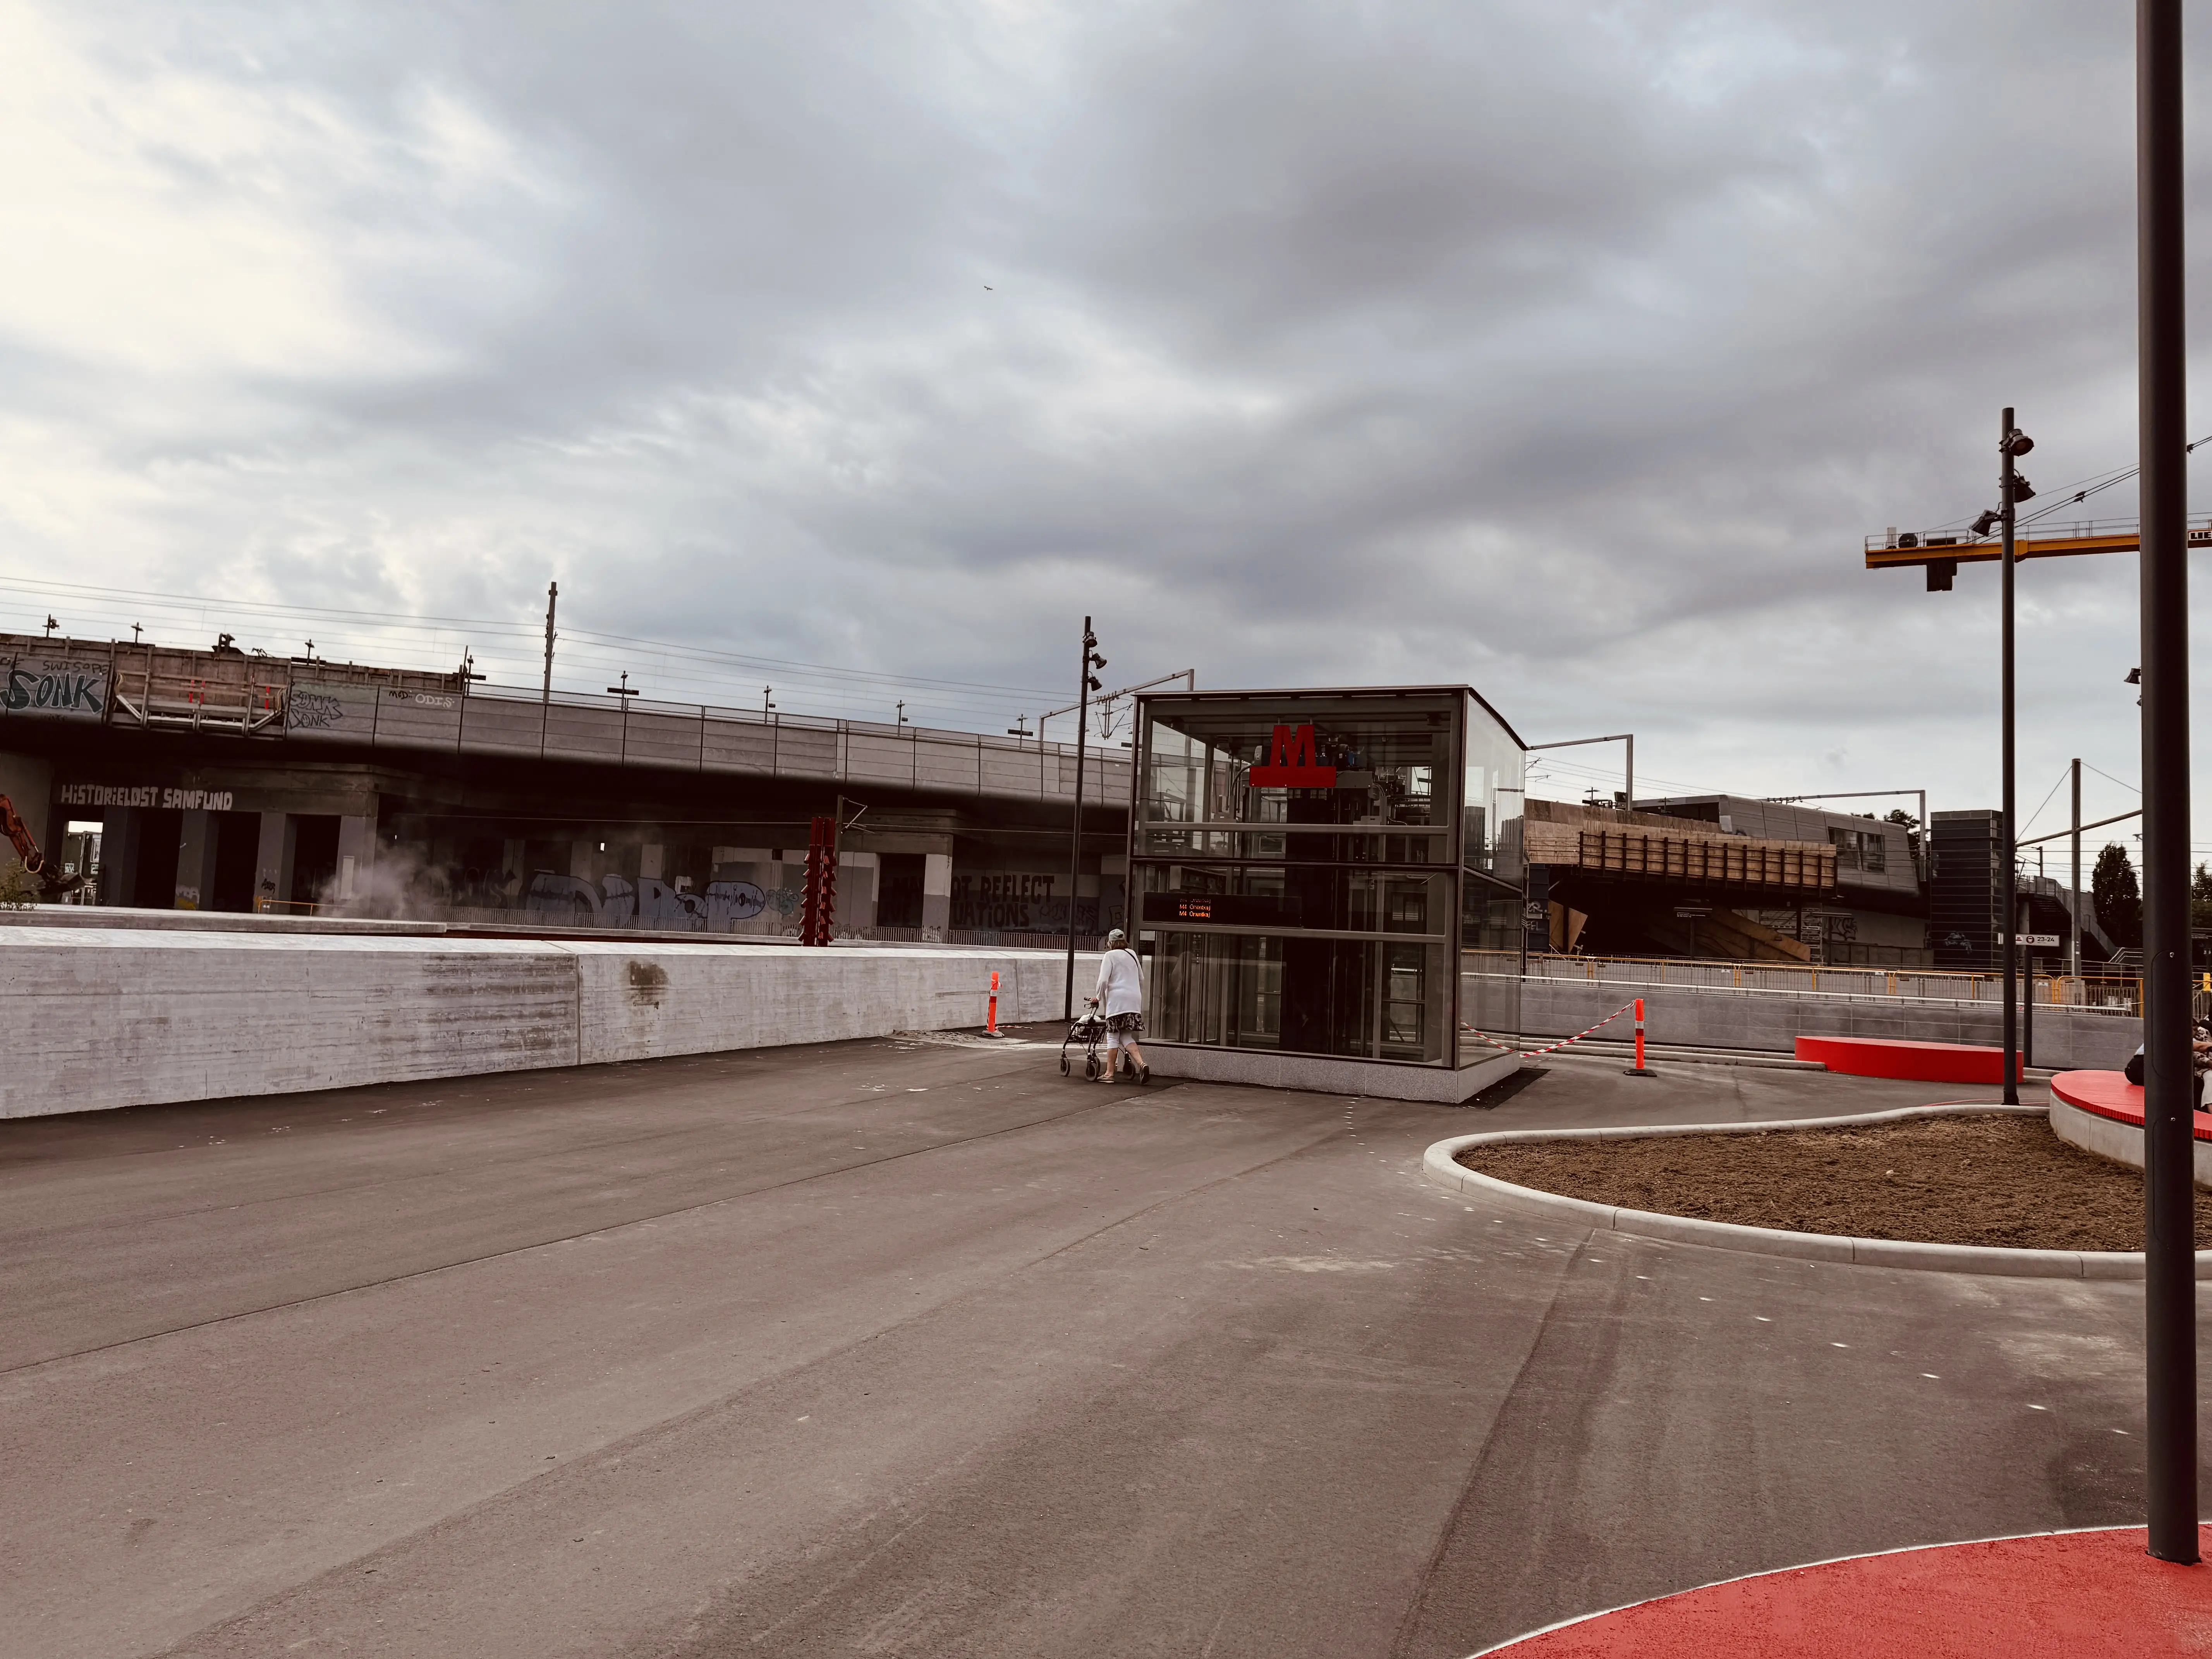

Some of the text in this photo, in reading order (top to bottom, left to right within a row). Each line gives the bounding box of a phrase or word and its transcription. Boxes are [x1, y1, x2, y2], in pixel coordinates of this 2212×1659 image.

[0, 668, 104, 715] SONK
[289, 708, 330, 730] SONK
[1269, 725, 1316, 766] M
[162, 788, 233, 811] SAMFUND
[980, 875, 1055, 904] REFLECT
